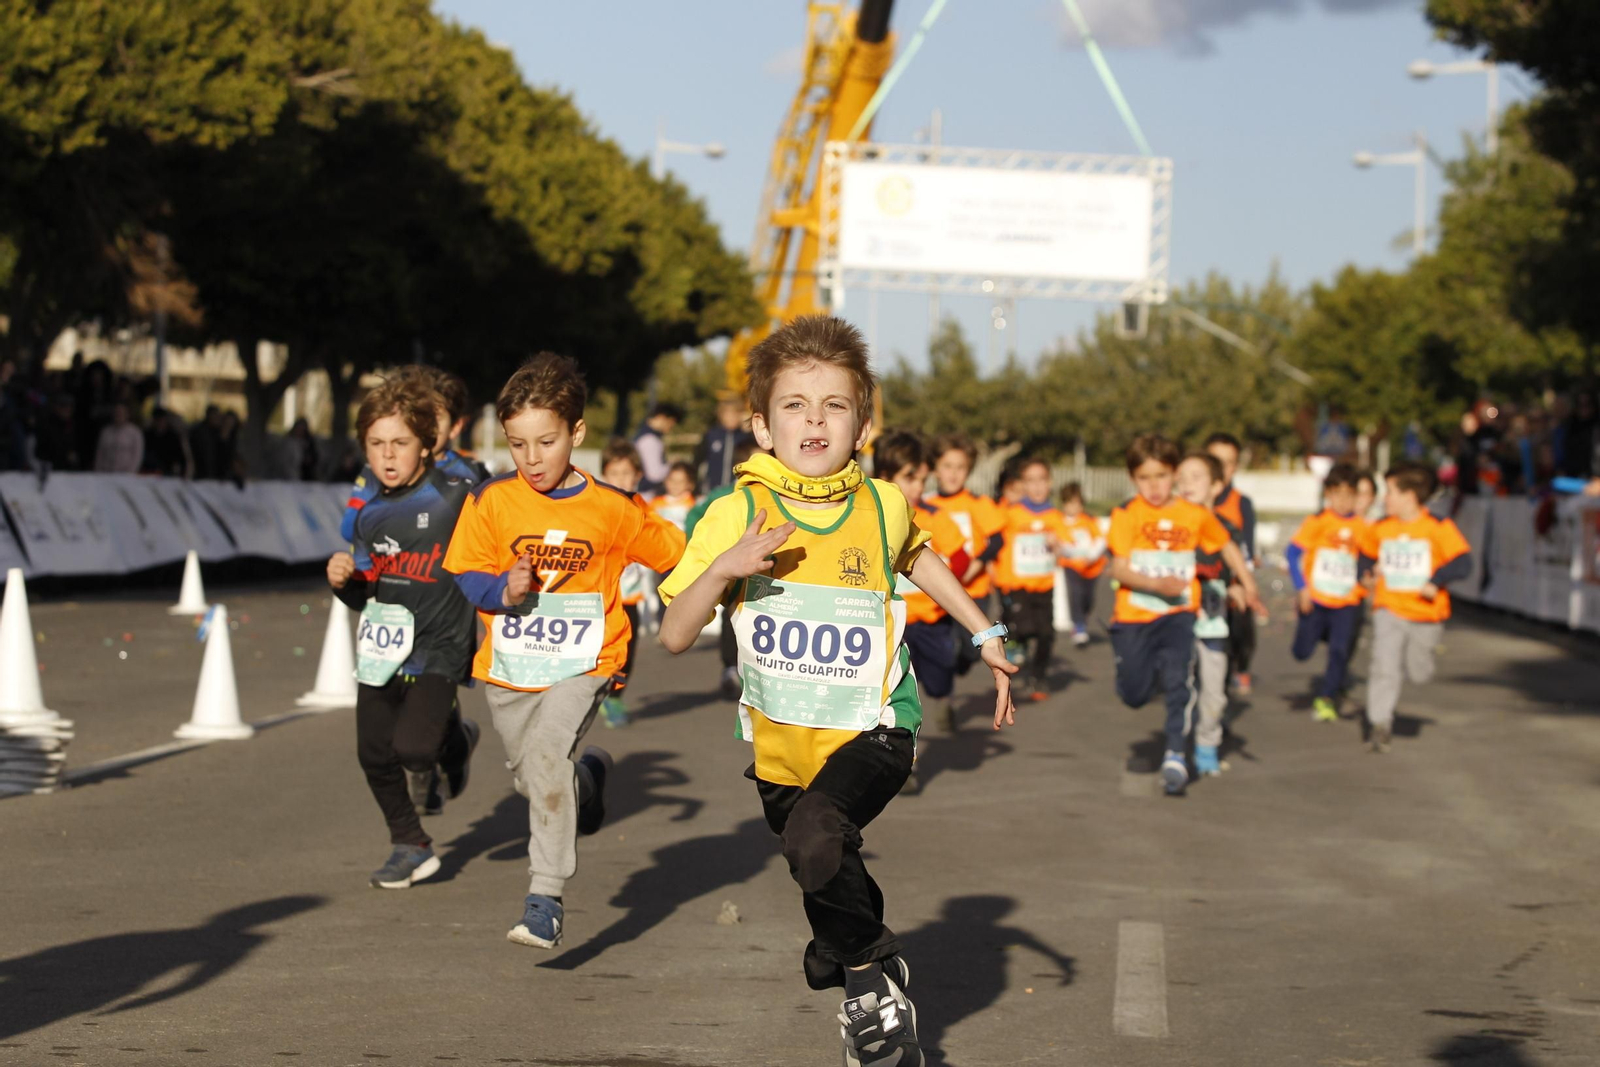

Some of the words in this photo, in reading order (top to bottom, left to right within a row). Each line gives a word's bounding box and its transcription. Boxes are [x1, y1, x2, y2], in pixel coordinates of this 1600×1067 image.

[524, 544, 584, 560] SUPER
[517, 557, 589, 573] UNNER
[563, 599, 597, 607] CARRERA
[769, 595, 804, 605] MARATÓN
[834, 597, 876, 608] CARRERA
[768, 602, 799, 612] ALMERÍA
[835, 608, 877, 619] INFANTIL
[502, 613, 592, 645] 8497
[752, 615, 871, 666] 8009
[524, 642, 562, 653] MANUEL
[756, 655, 795, 672] HIJITO
[798, 663, 858, 679] GUAPITO!
